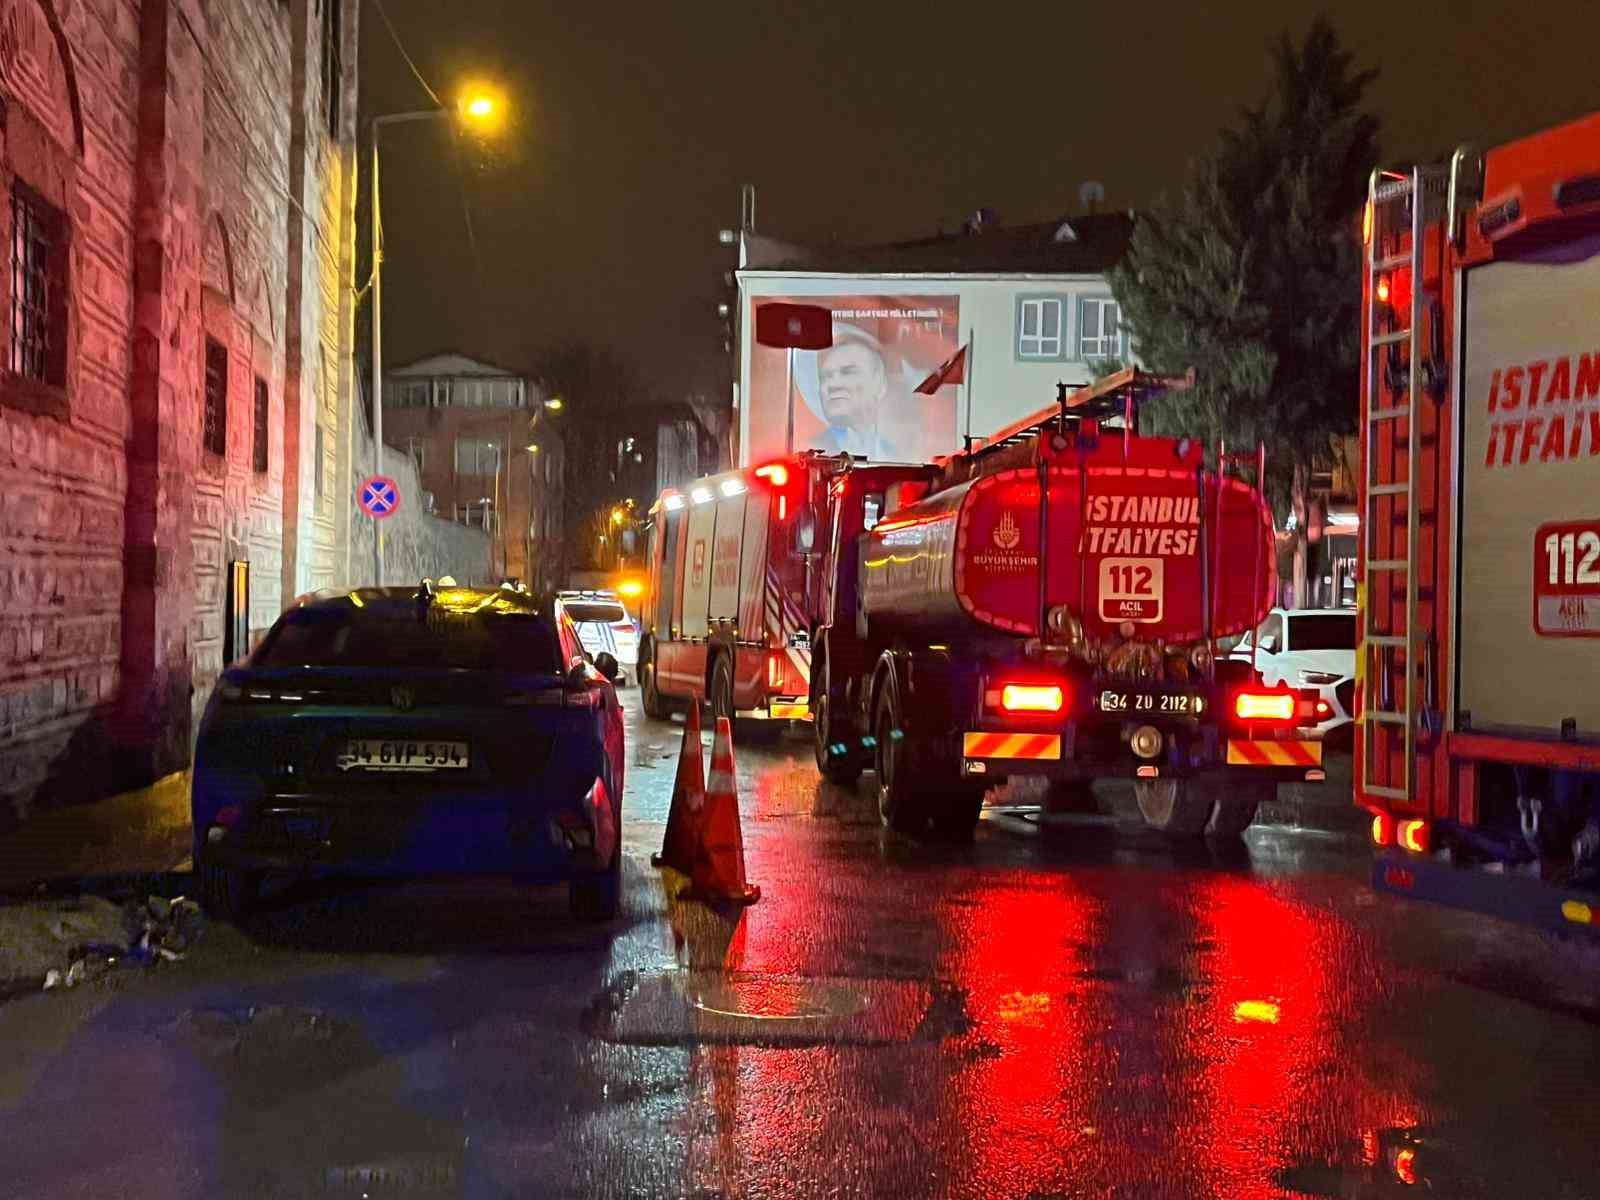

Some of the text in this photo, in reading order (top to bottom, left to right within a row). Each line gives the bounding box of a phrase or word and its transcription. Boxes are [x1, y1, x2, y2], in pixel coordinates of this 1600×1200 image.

[1545, 530, 1600, 584] 112
[1109, 565, 1153, 594] 112
[1110, 694, 1127, 709] 34
[1160, 694, 1188, 711] 2112
[424, 743, 461, 766] 534
